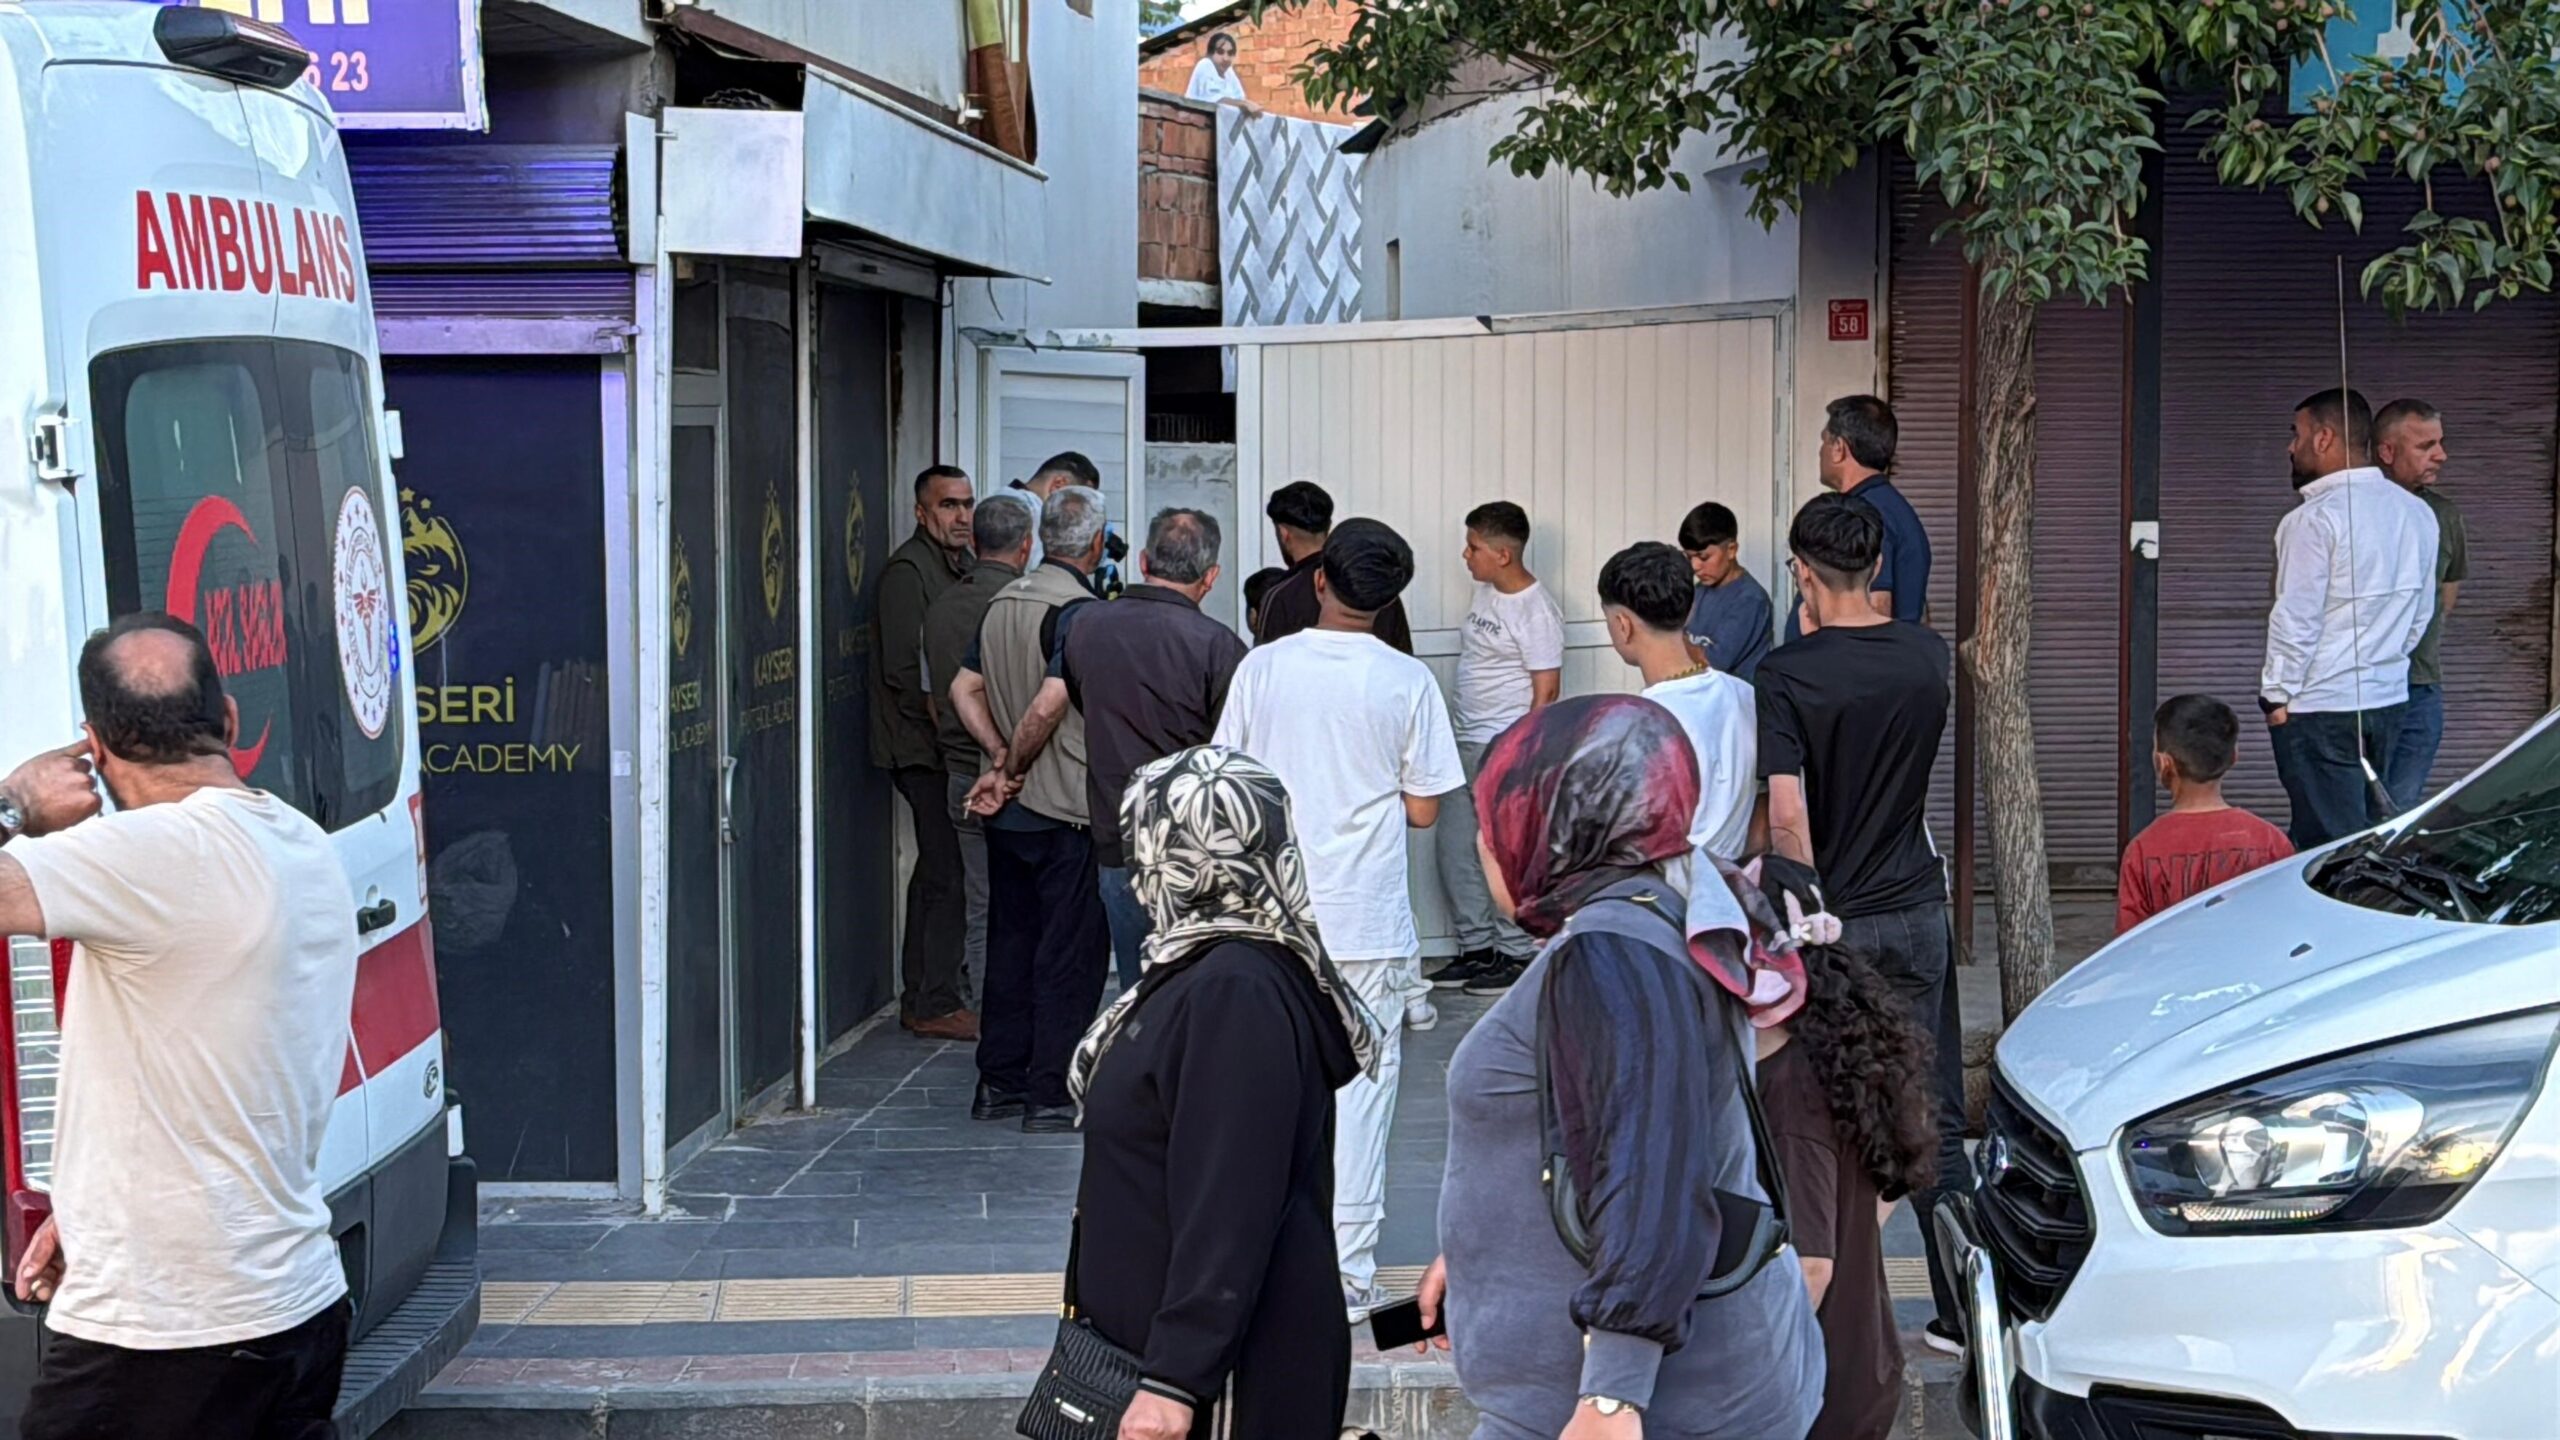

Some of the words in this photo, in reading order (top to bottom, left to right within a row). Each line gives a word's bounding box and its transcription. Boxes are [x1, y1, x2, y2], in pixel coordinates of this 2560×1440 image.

[331, 51, 368, 91] 23
[136, 190, 356, 303] AMBULANS
[1839, 316, 1858, 333] 58
[423, 743, 581, 773] CADEMY
